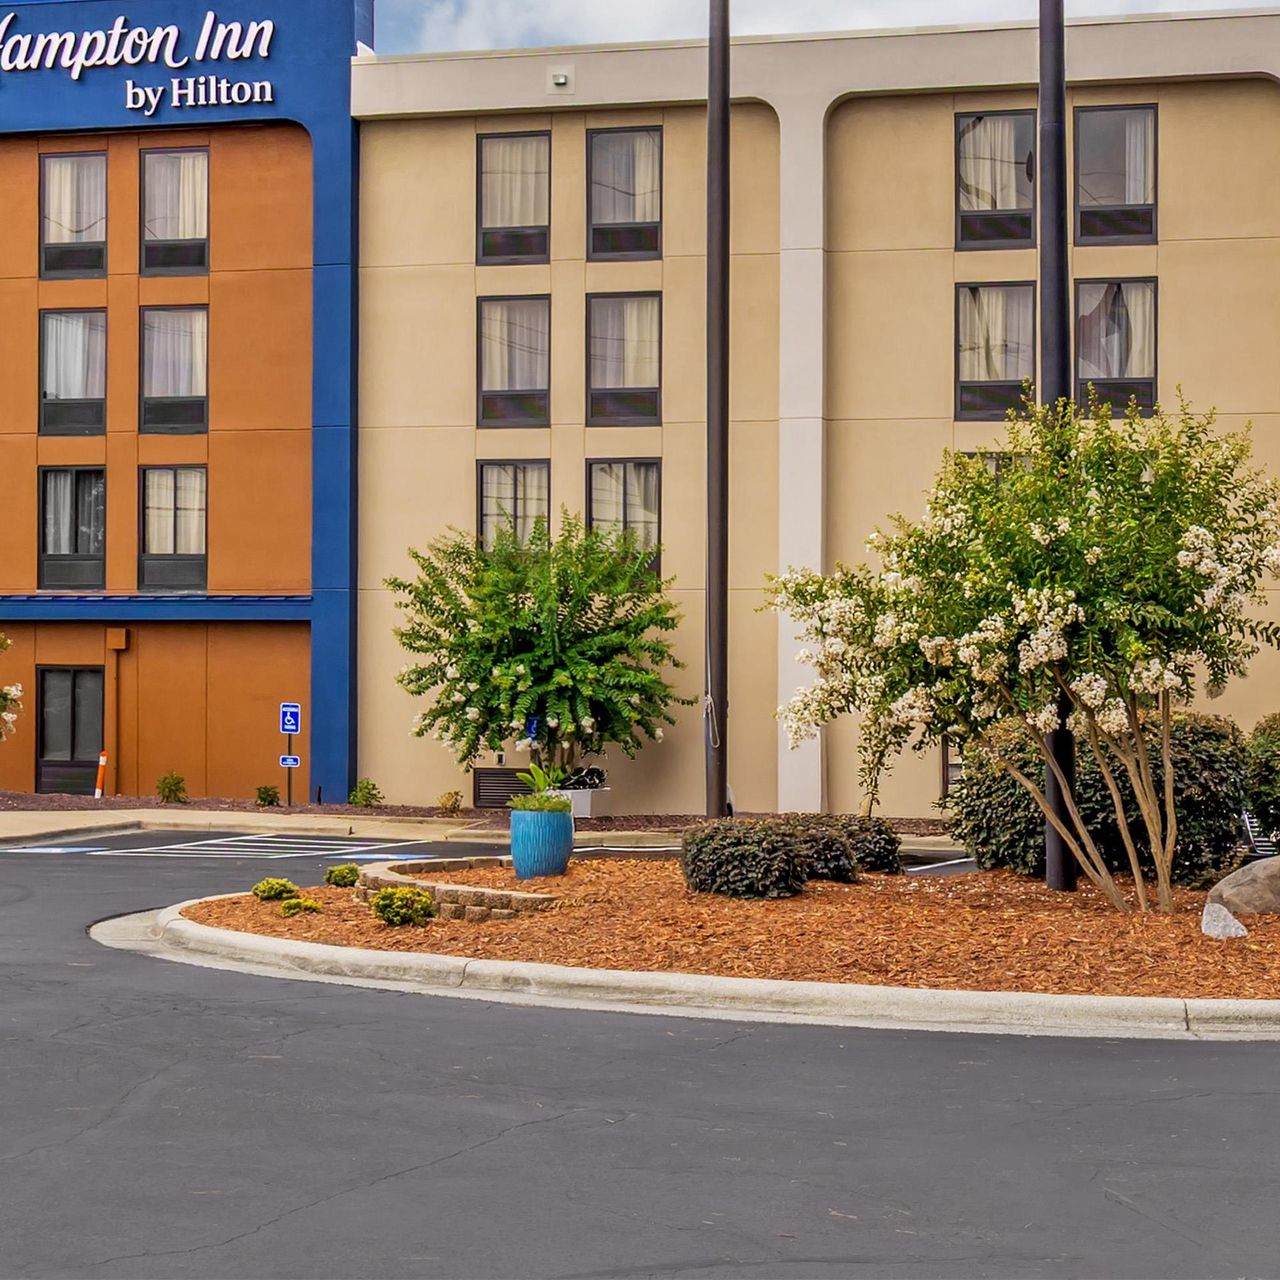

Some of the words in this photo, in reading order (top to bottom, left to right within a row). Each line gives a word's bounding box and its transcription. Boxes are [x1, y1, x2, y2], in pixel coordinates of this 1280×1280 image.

[195, 11, 275, 61] Inn
[125, 79, 165, 116] by
[170, 75, 274, 107] Hilton
